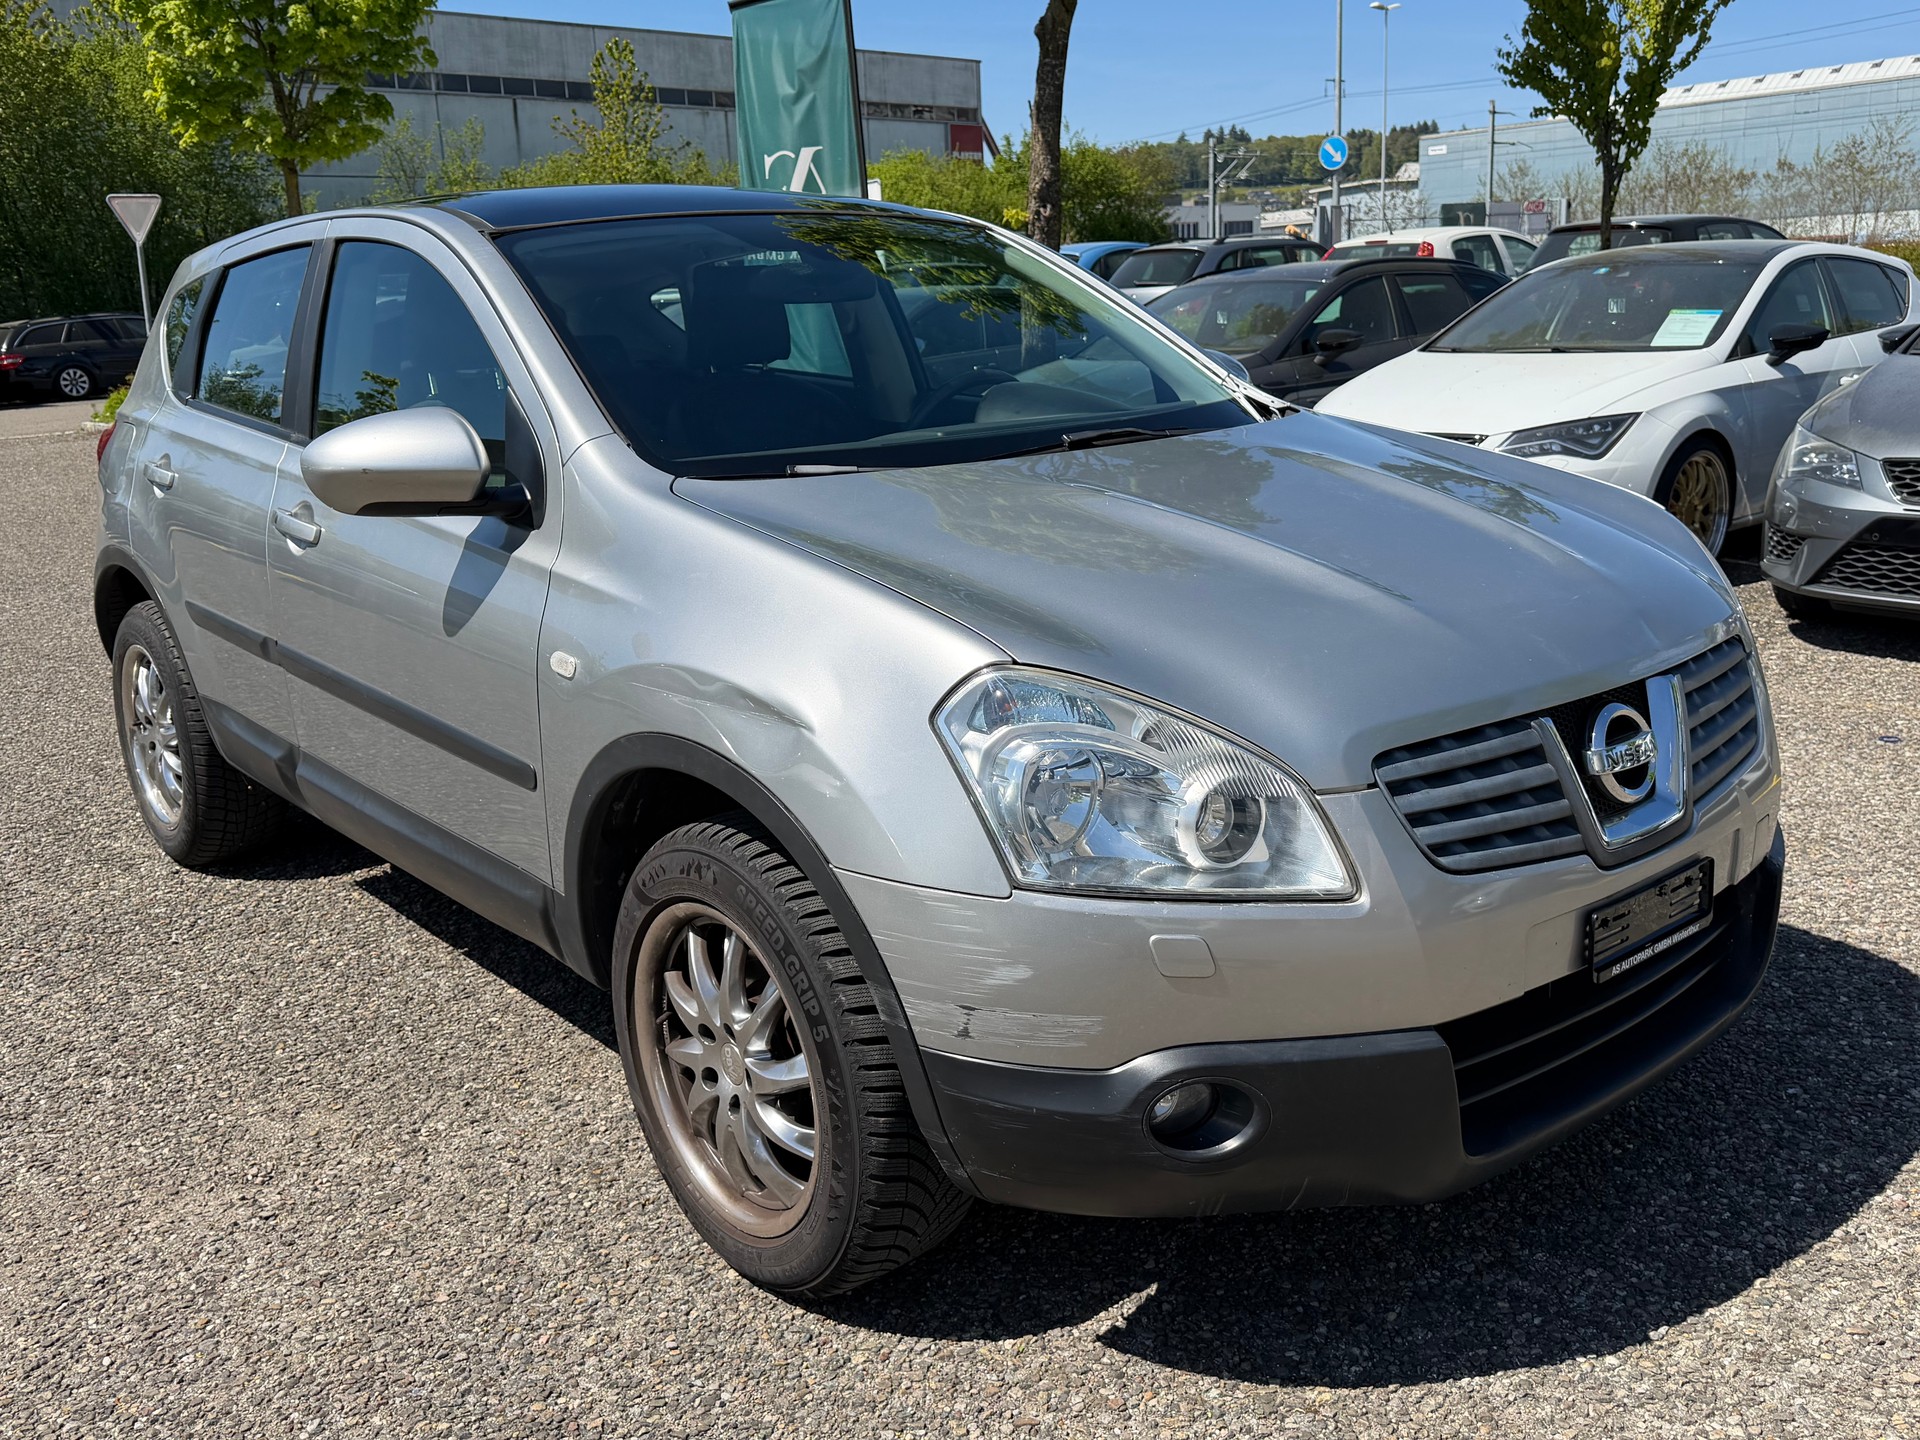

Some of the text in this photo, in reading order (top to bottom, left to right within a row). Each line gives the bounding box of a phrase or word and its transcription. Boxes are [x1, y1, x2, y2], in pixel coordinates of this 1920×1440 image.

[736, 884, 830, 1043] SPEED-GRIP 5
[1611, 923, 1700, 976] AS AUTOPARK GMBH Winterthur
